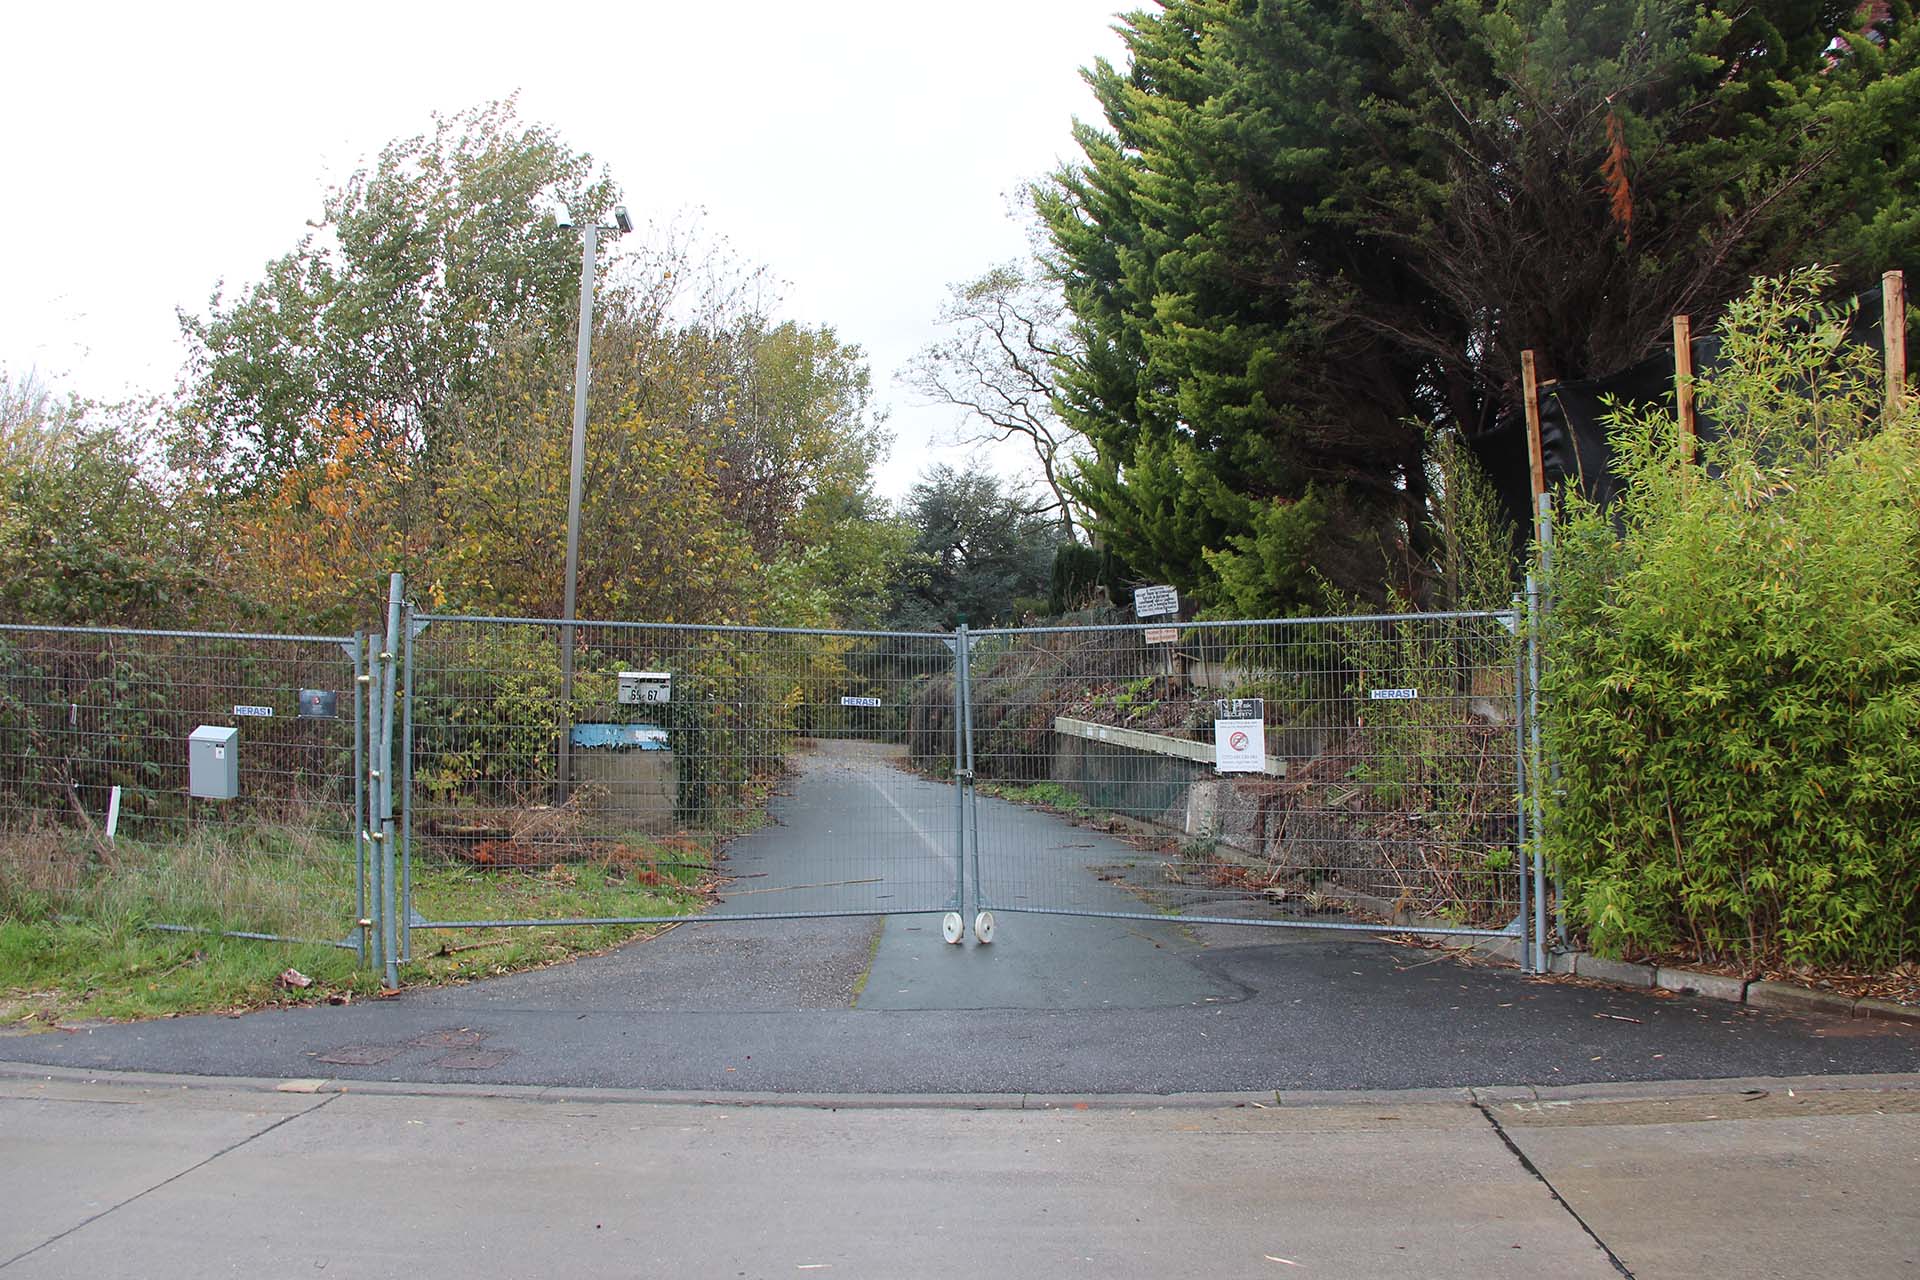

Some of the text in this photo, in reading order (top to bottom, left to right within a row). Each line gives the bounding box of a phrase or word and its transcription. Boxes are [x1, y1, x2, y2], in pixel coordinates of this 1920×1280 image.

[648, 690, 658, 700] 67
[1374, 690, 1410, 698] HERAS
[236, 706, 266, 715] HERAS
